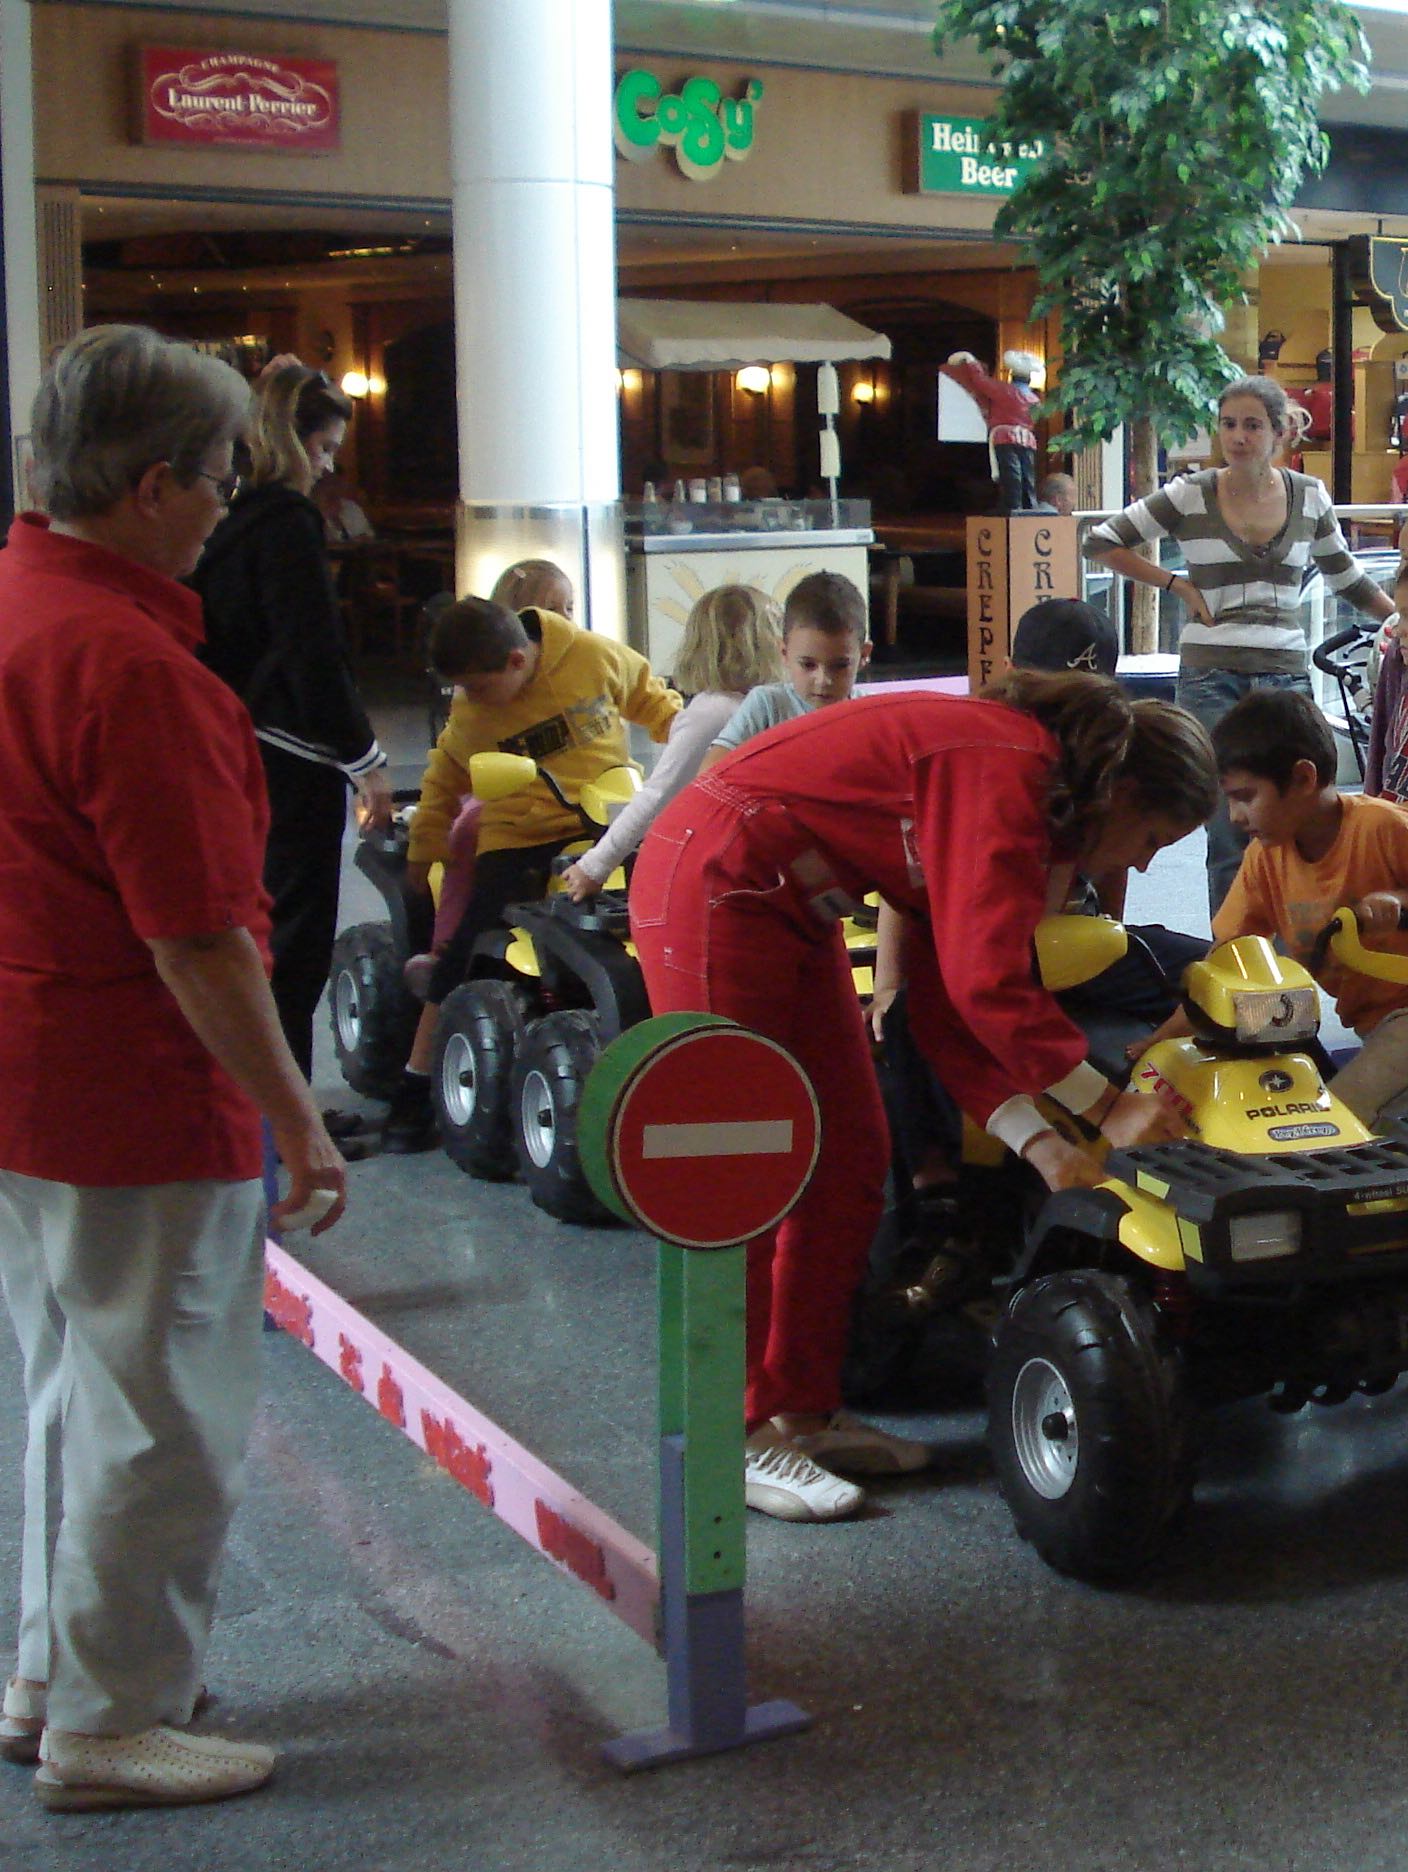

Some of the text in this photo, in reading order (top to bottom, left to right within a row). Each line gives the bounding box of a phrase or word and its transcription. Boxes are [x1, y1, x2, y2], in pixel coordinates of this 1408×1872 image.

[201, 55, 280, 74] CHAMPAGNE
[961, 156, 1017, 187] Beer
[1033, 528, 1054, 605] CR
